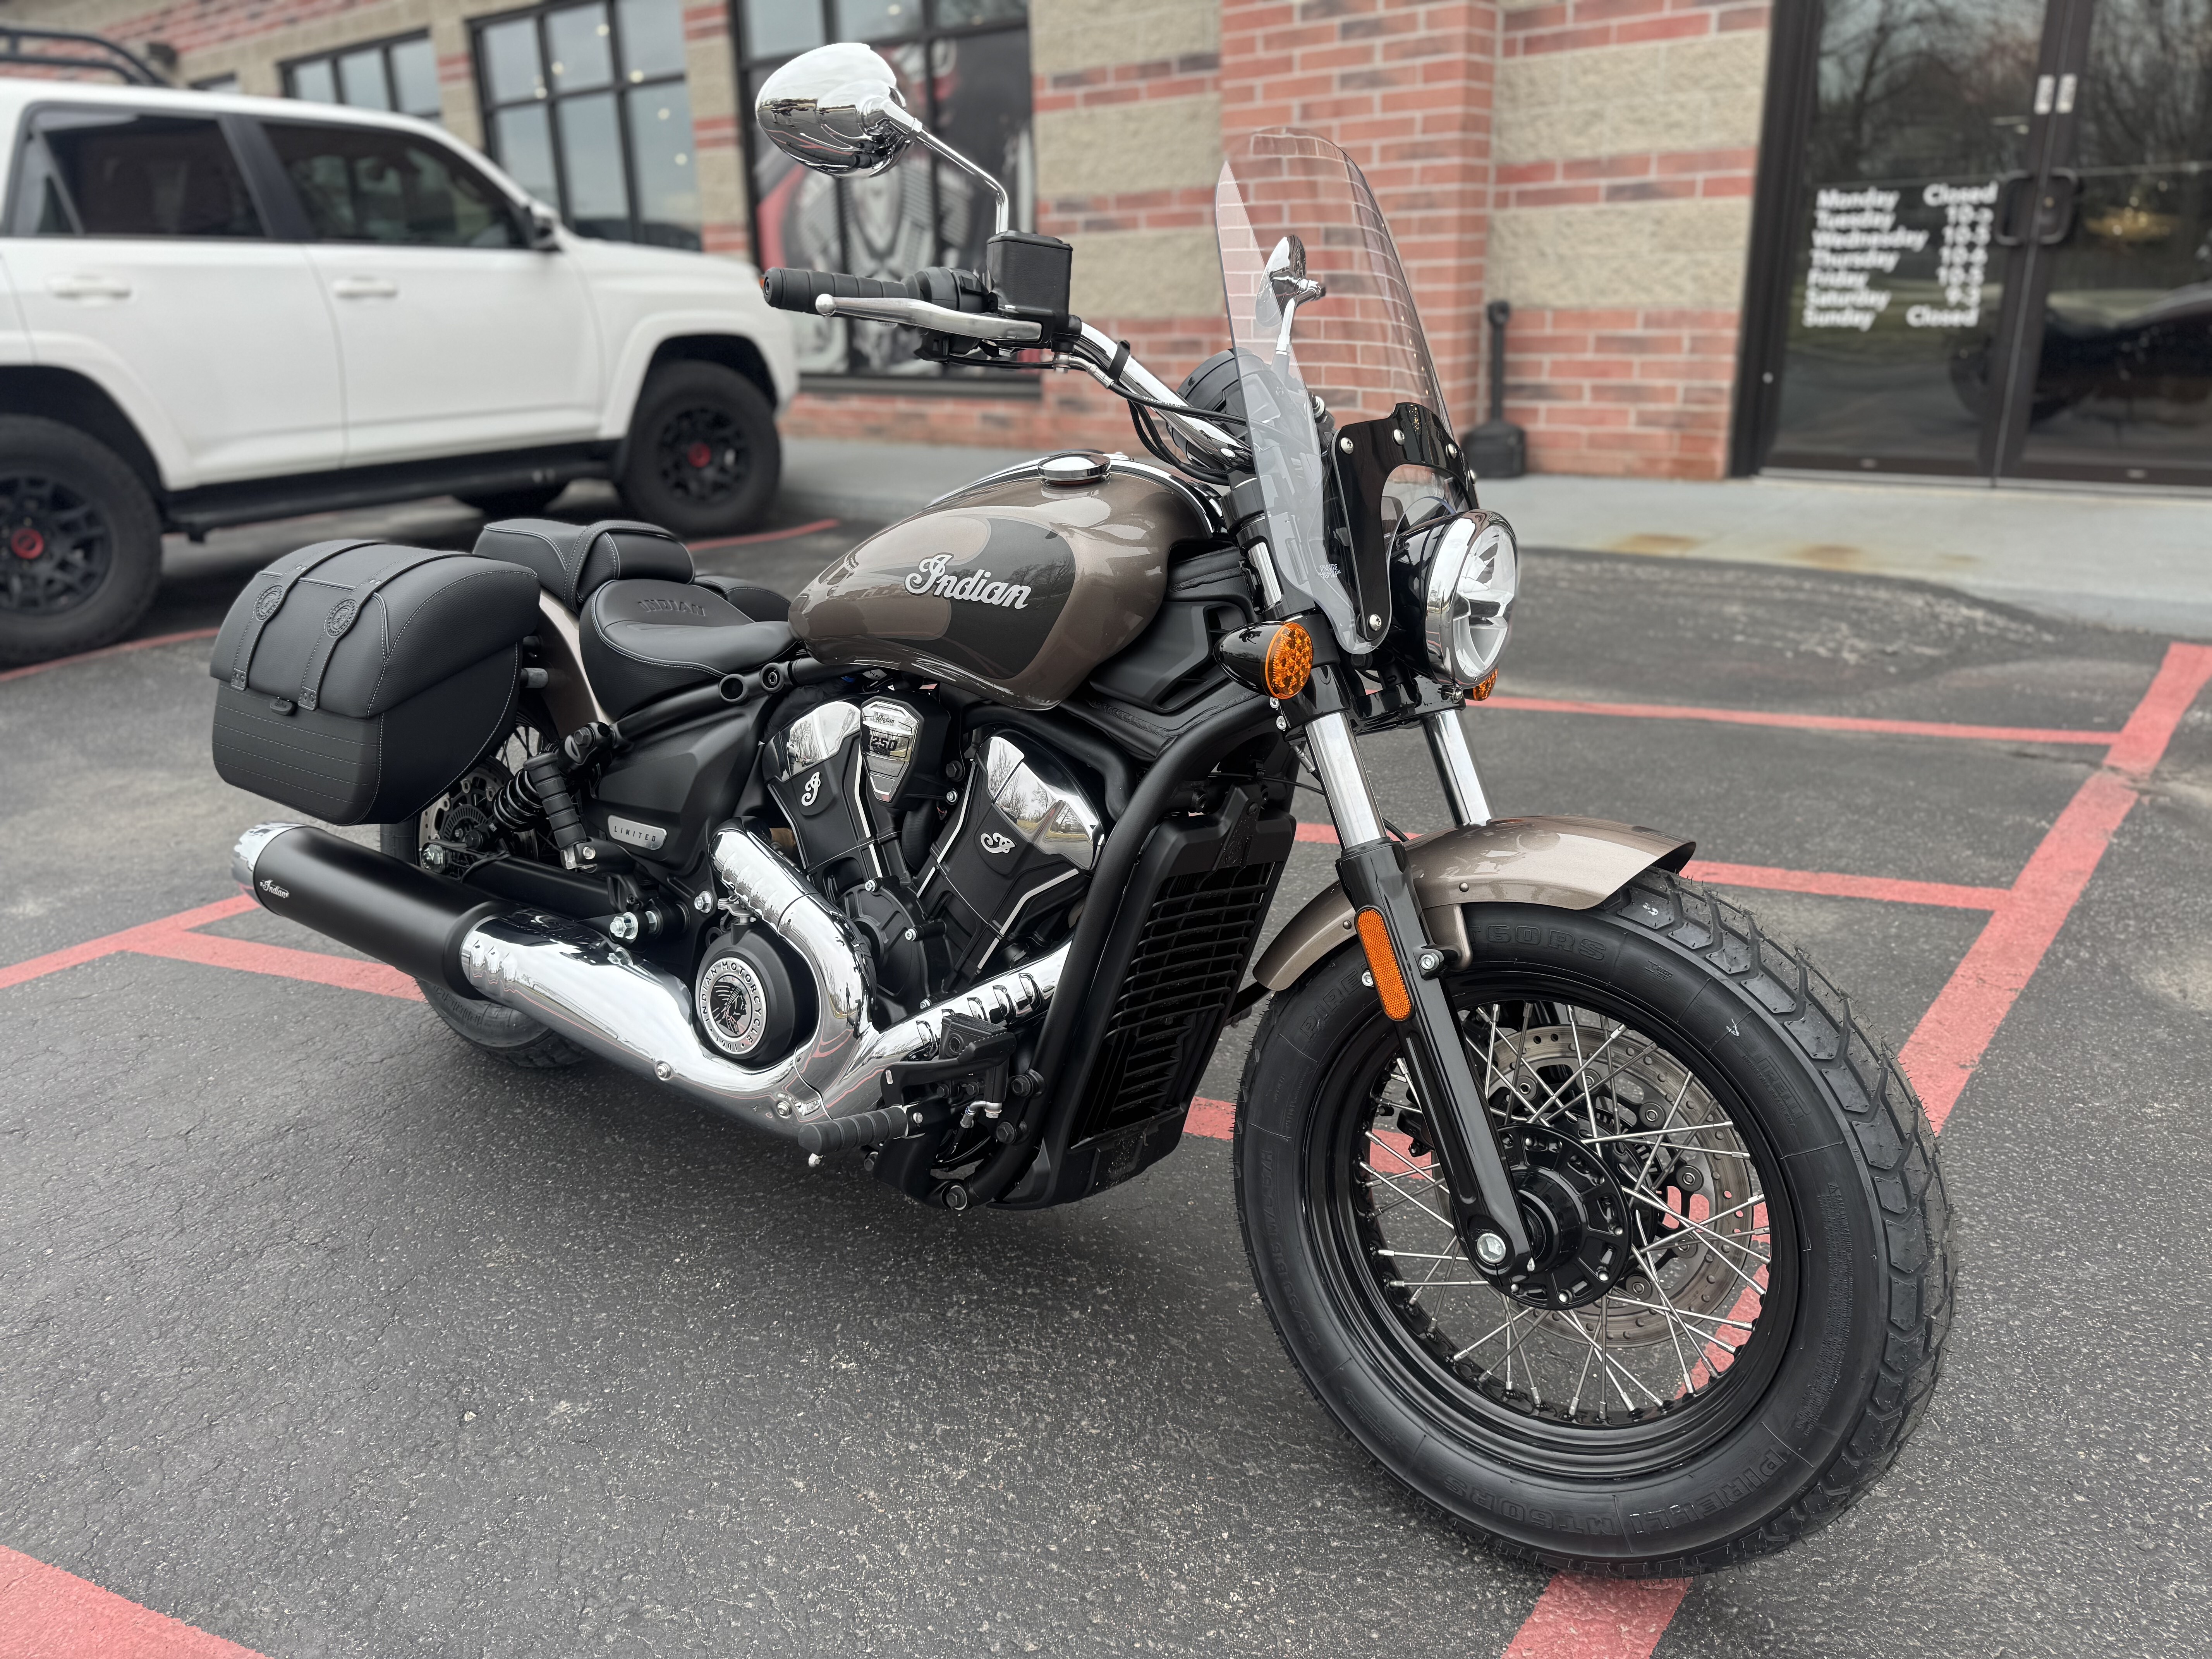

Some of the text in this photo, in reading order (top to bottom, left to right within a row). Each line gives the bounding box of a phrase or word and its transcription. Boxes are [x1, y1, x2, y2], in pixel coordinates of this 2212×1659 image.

[1817, 180, 1998, 211] Monday Closed
[1815, 208, 1895, 231] Tuesday
[1812, 226, 1929, 252] Wednesday
[1810, 246, 1899, 272] Thursday
[1808, 268, 1869, 289] Friday
[1805, 287, 1891, 311] Saturday
[1803, 305, 1979, 331] Sunday Closed
[905, 554, 1032, 610] Indian
[637, 599, 705, 617] INDIAN
[866, 735, 898, 751] 250
[614, 826, 656, 842] LIMITED
[262, 880, 286, 898] Indian
[1470, 924, 1606, 960] T60RS
[702, 961, 762, 1044] INDIAN MOTORCYCLE
[1300, 963, 1369, 1040] PIRE
[1630, 1448, 1787, 1534] PIRELLI
[1443, 1474, 1616, 1535] MT60RS
